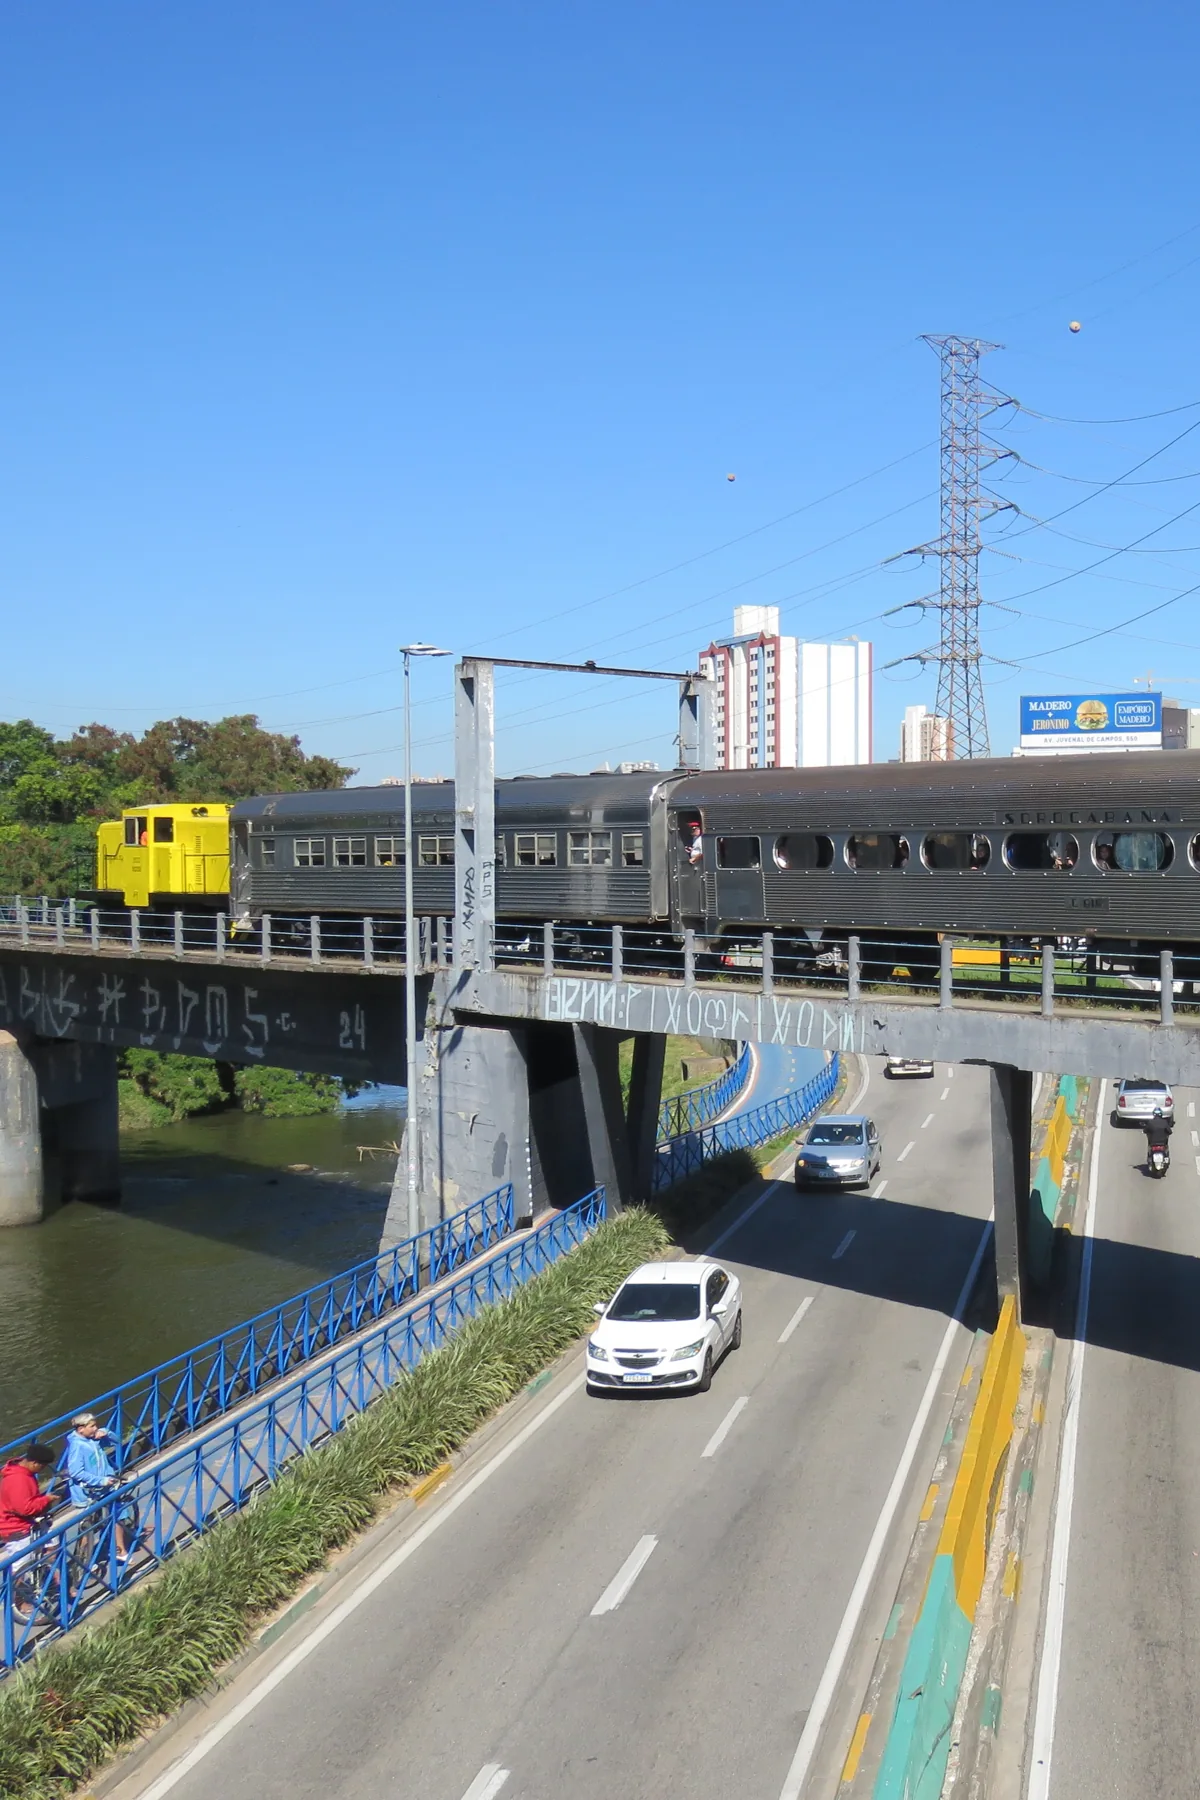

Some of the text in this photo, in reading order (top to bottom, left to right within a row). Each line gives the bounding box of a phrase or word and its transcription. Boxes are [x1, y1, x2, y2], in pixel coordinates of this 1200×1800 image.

[1028, 700, 1072, 711] MADERO
[1118, 715, 1150, 724] MADERO
[1004, 811, 1171, 825] SOROCABANA
